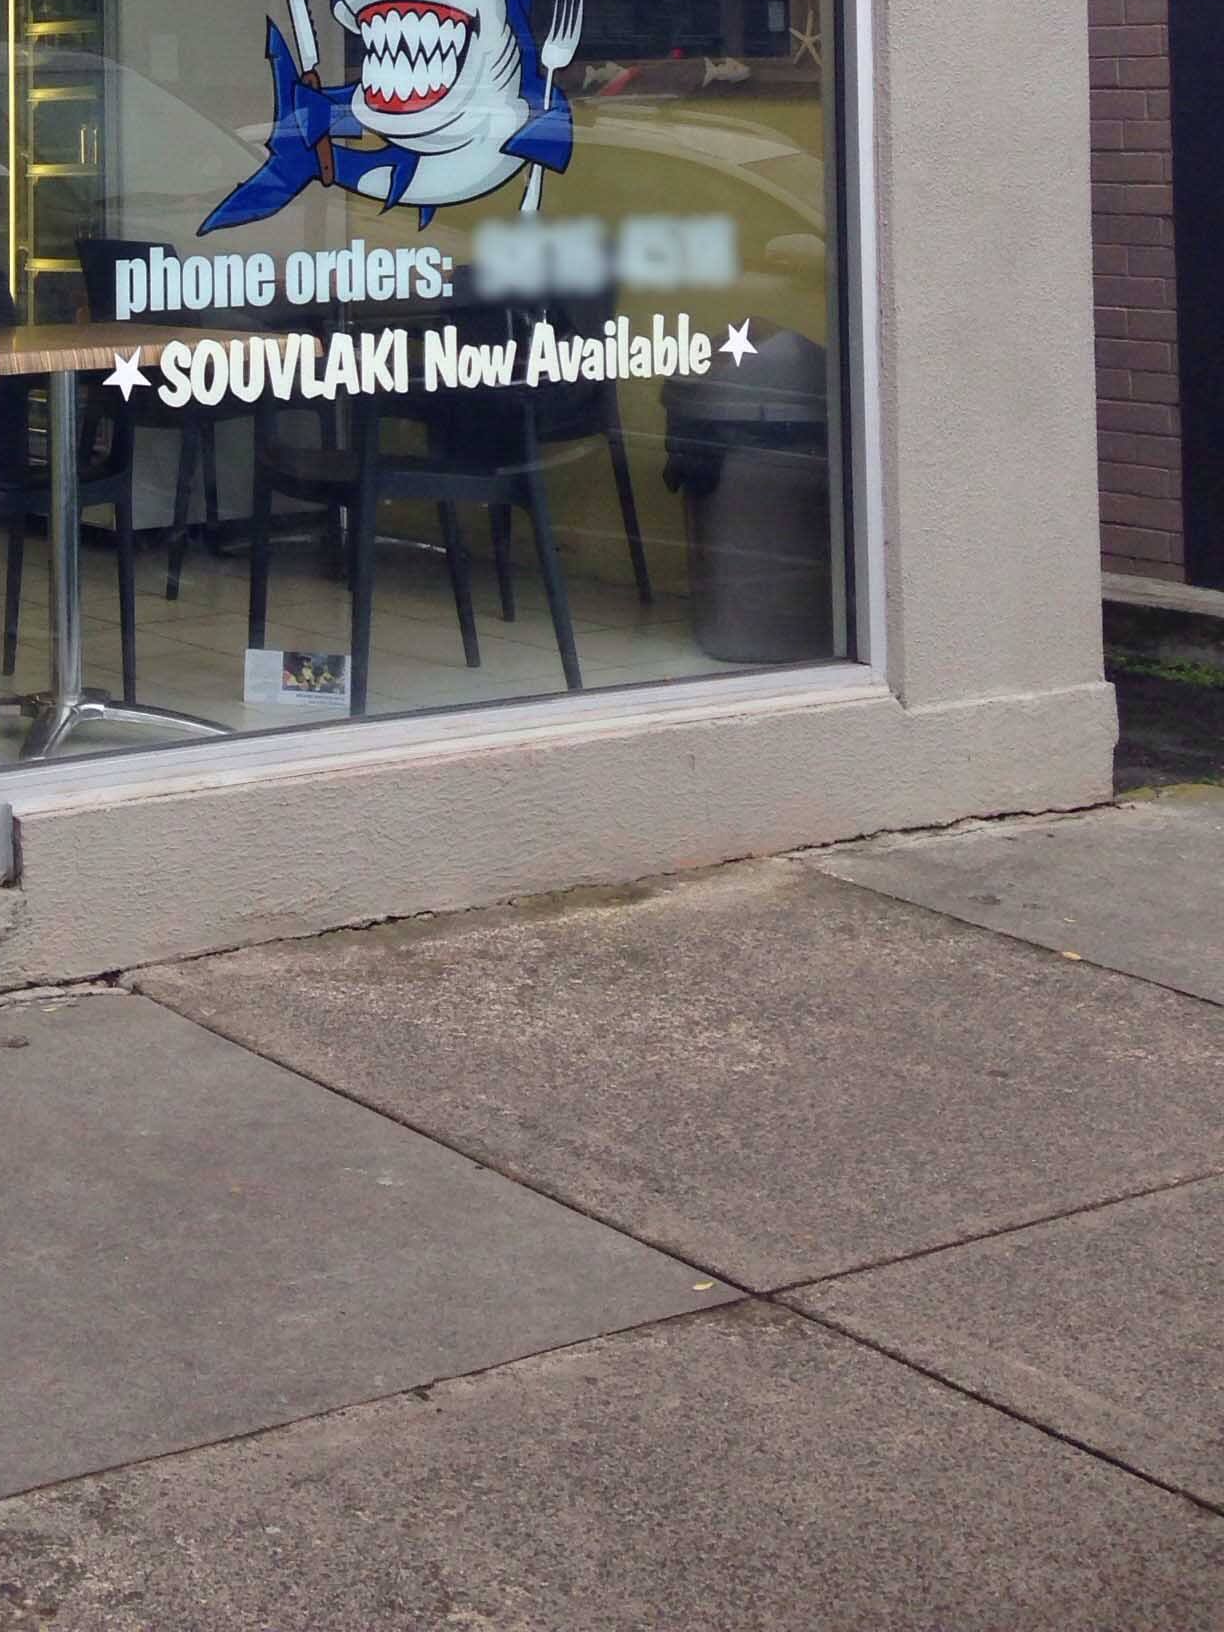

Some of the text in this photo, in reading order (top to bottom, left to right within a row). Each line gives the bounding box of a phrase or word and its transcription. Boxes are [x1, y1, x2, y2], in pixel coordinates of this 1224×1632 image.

[115, 245, 276, 321] phone
[284, 239, 454, 305] orders:
[157, 312, 712, 408] SOUVLAKI Now Available
